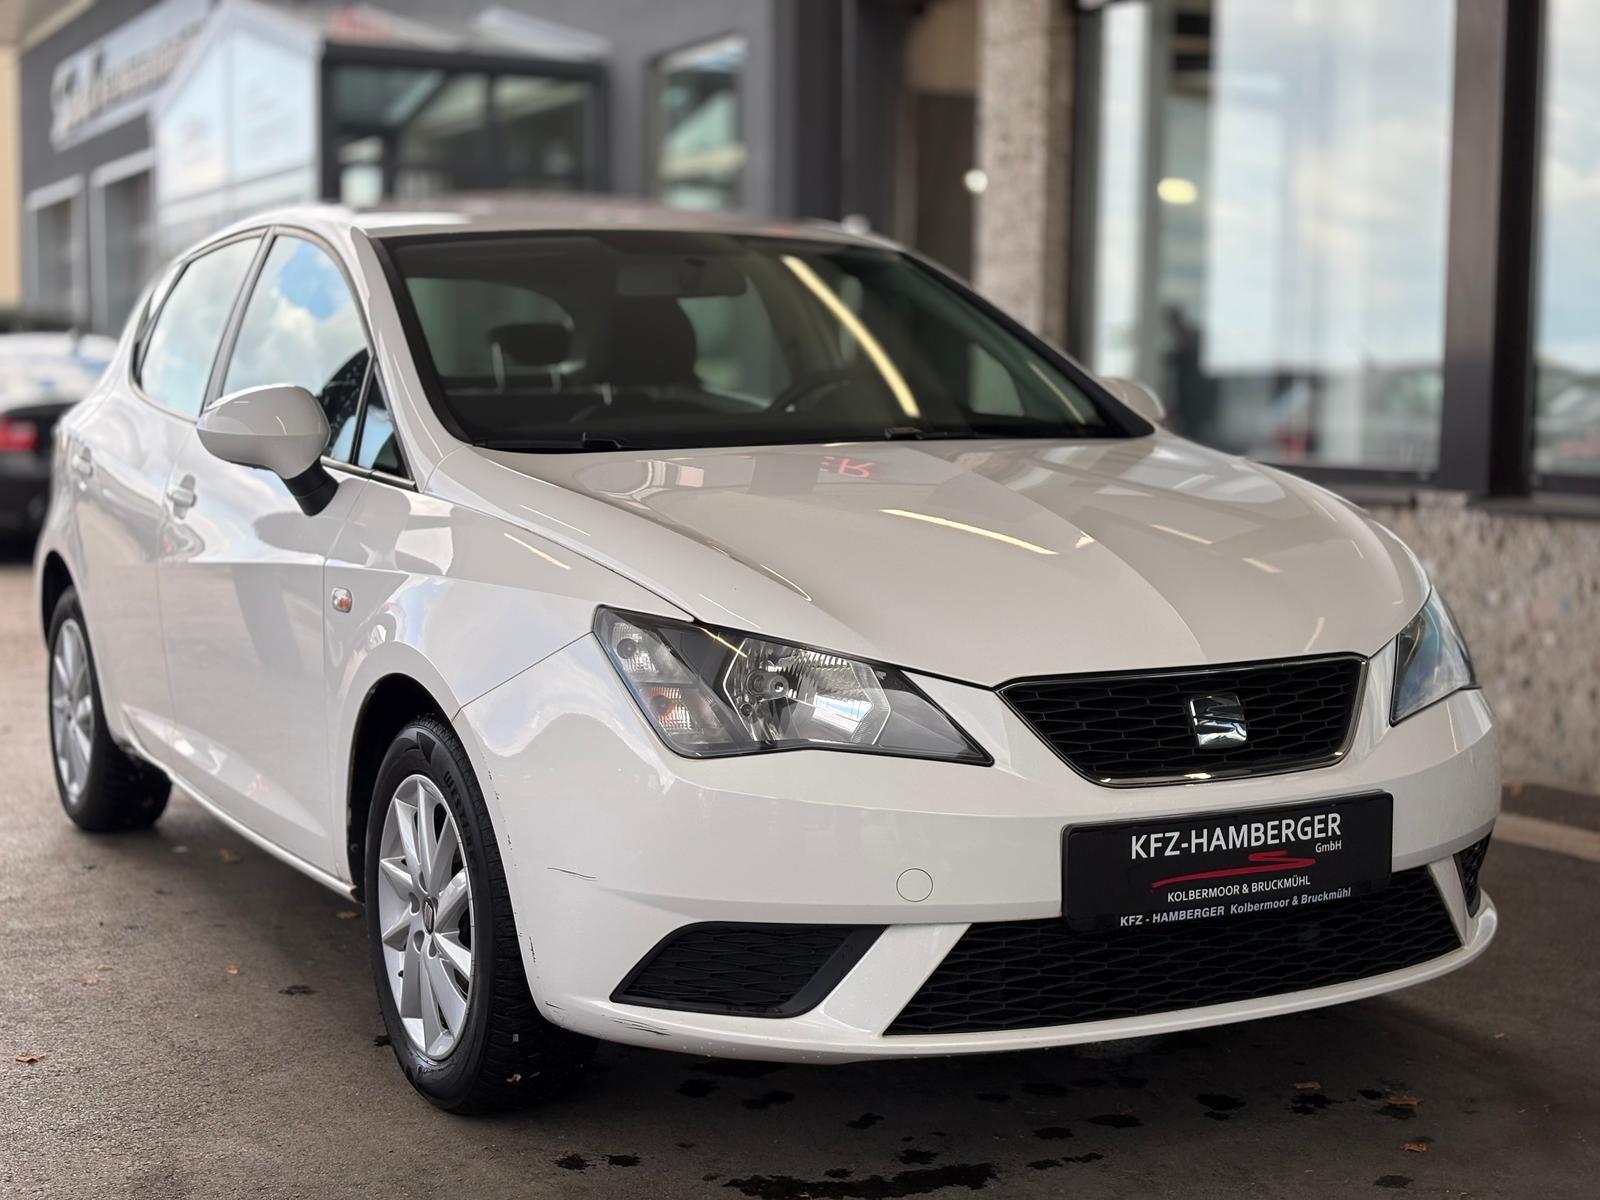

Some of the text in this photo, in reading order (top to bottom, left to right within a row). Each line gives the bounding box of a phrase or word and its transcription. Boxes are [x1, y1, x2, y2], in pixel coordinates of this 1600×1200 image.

[1131, 813, 1342, 859] KFZ-HAMBERGER
[1315, 839, 1342, 854] GmbH
[1167, 875, 1311, 903] KOLBERMOOR & BRUCKMÜHL
[1120, 915, 1143, 927] KFZ
[1152, 905, 1225, 925] HAMBERGER
[1230, 898, 1290, 915] Kolbermoor
[1291, 895, 1299, 906] &
[1301, 887, 1351, 904] Bruckmühl
